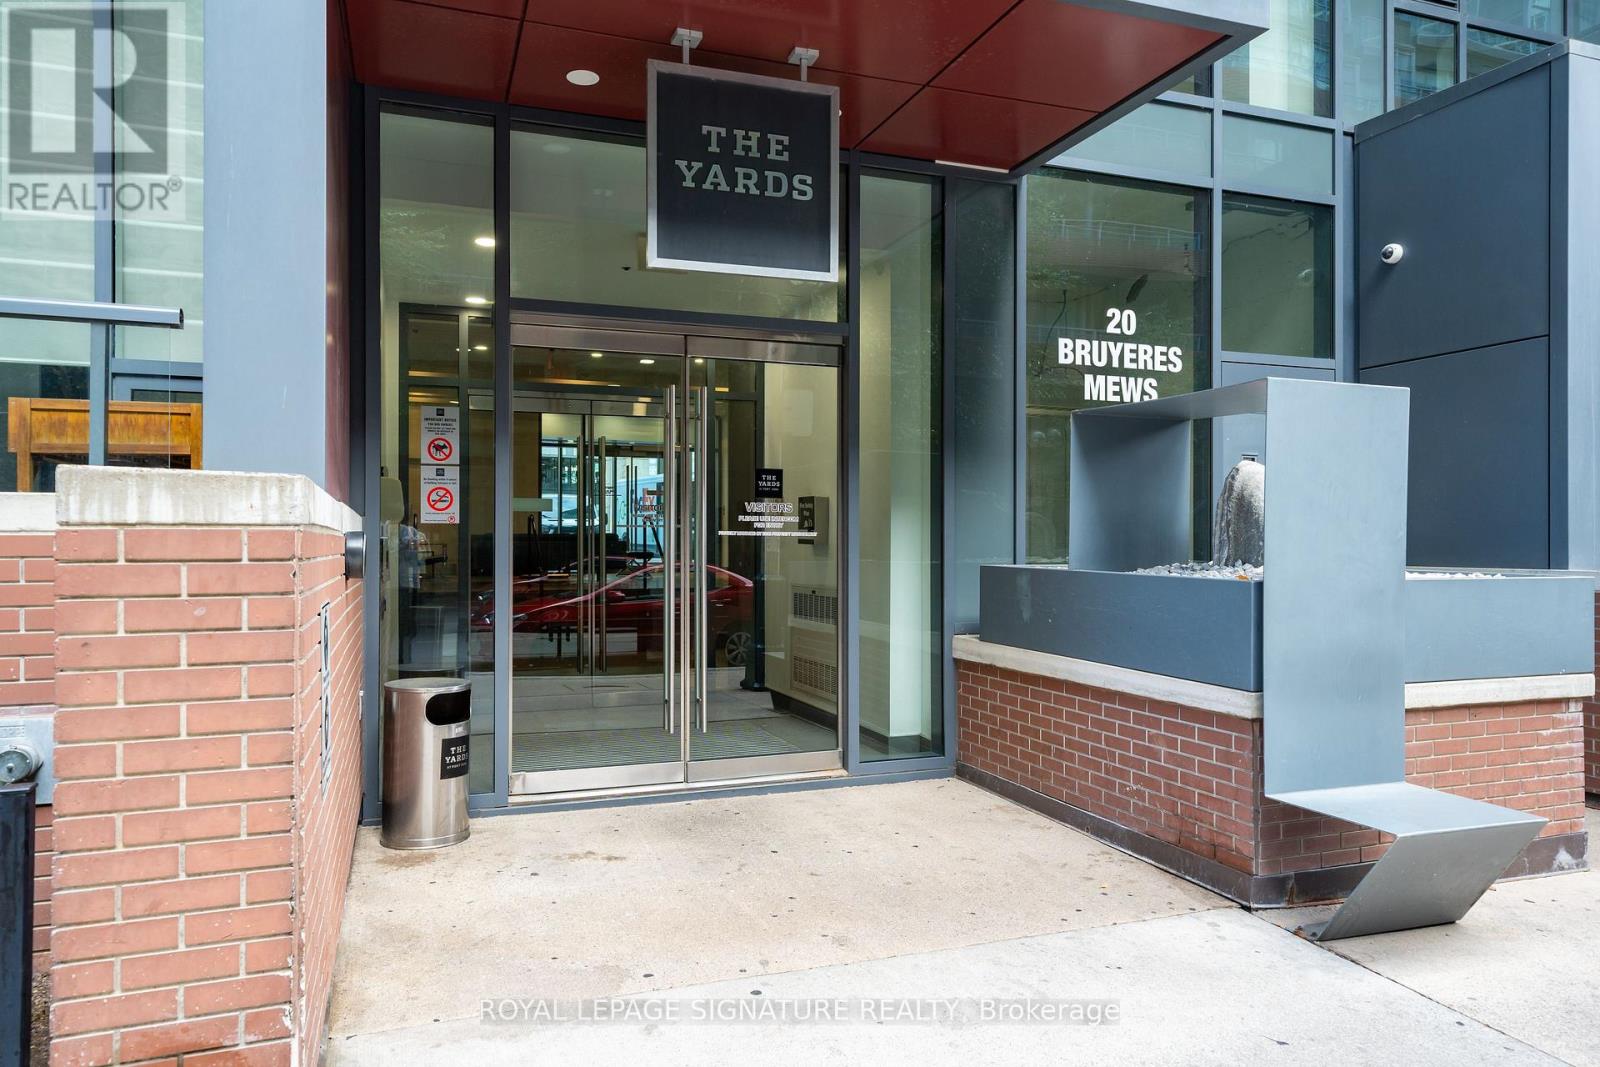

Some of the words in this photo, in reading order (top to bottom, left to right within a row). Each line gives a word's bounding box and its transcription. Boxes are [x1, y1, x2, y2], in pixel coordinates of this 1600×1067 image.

[701, 125, 790, 162] THE
[674, 159, 814, 201] YARDS
[1106, 307, 1137, 336] 20
[1058, 337, 1183, 373] BRUYERES
[1084, 373, 1159, 403] MEWS
[744, 501, 793, 513] VISITORS
[444, 752, 469, 764] YARDS
[450, 744, 467, 755] THE
